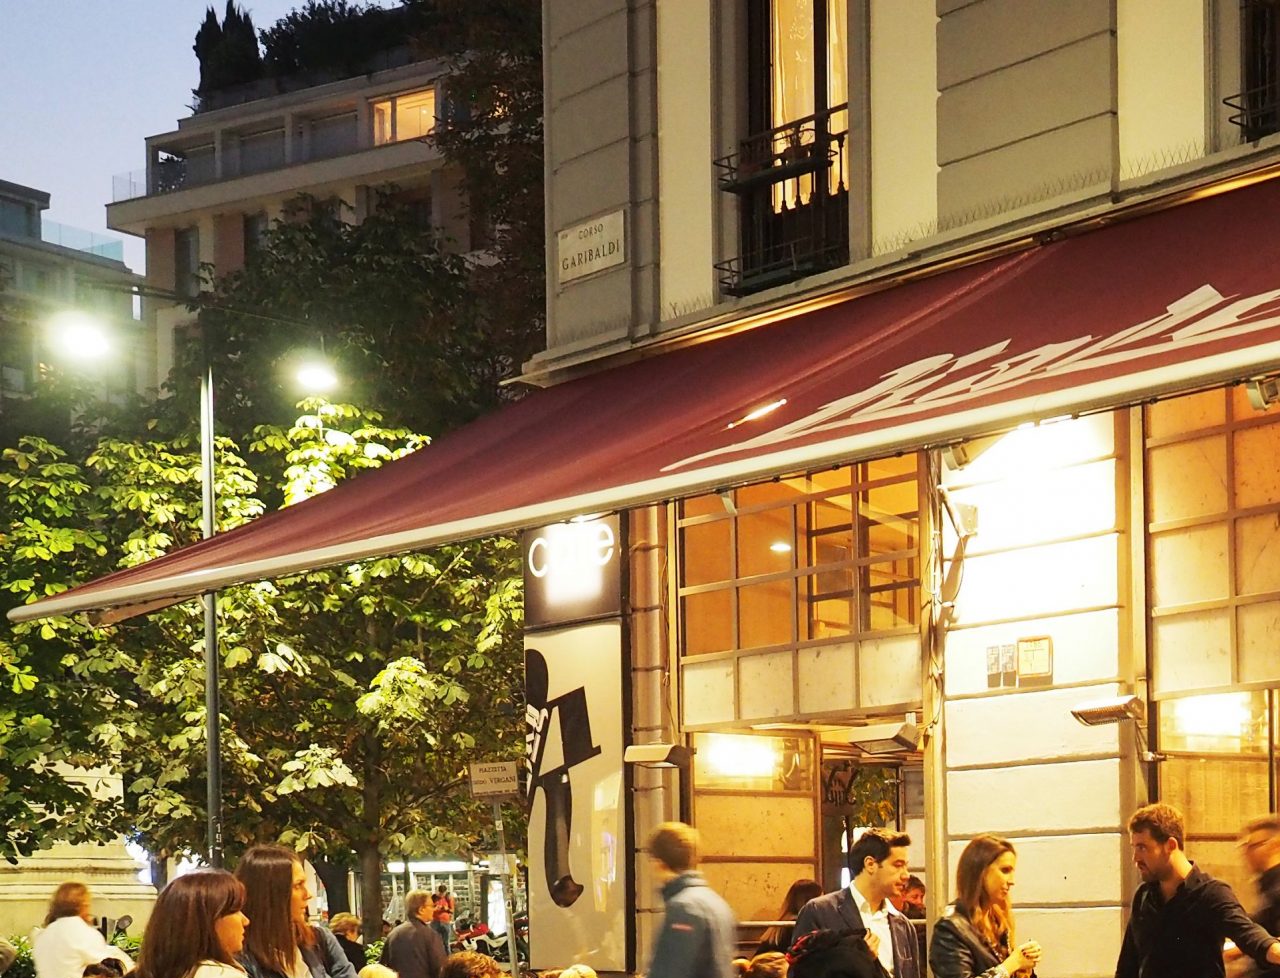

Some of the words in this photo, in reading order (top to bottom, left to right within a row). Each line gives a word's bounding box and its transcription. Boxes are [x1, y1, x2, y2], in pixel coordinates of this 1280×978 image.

[578, 223, 604, 240] CORSO
[562, 239, 619, 271] GARIBALDI
[528, 523, 615, 577] ce
